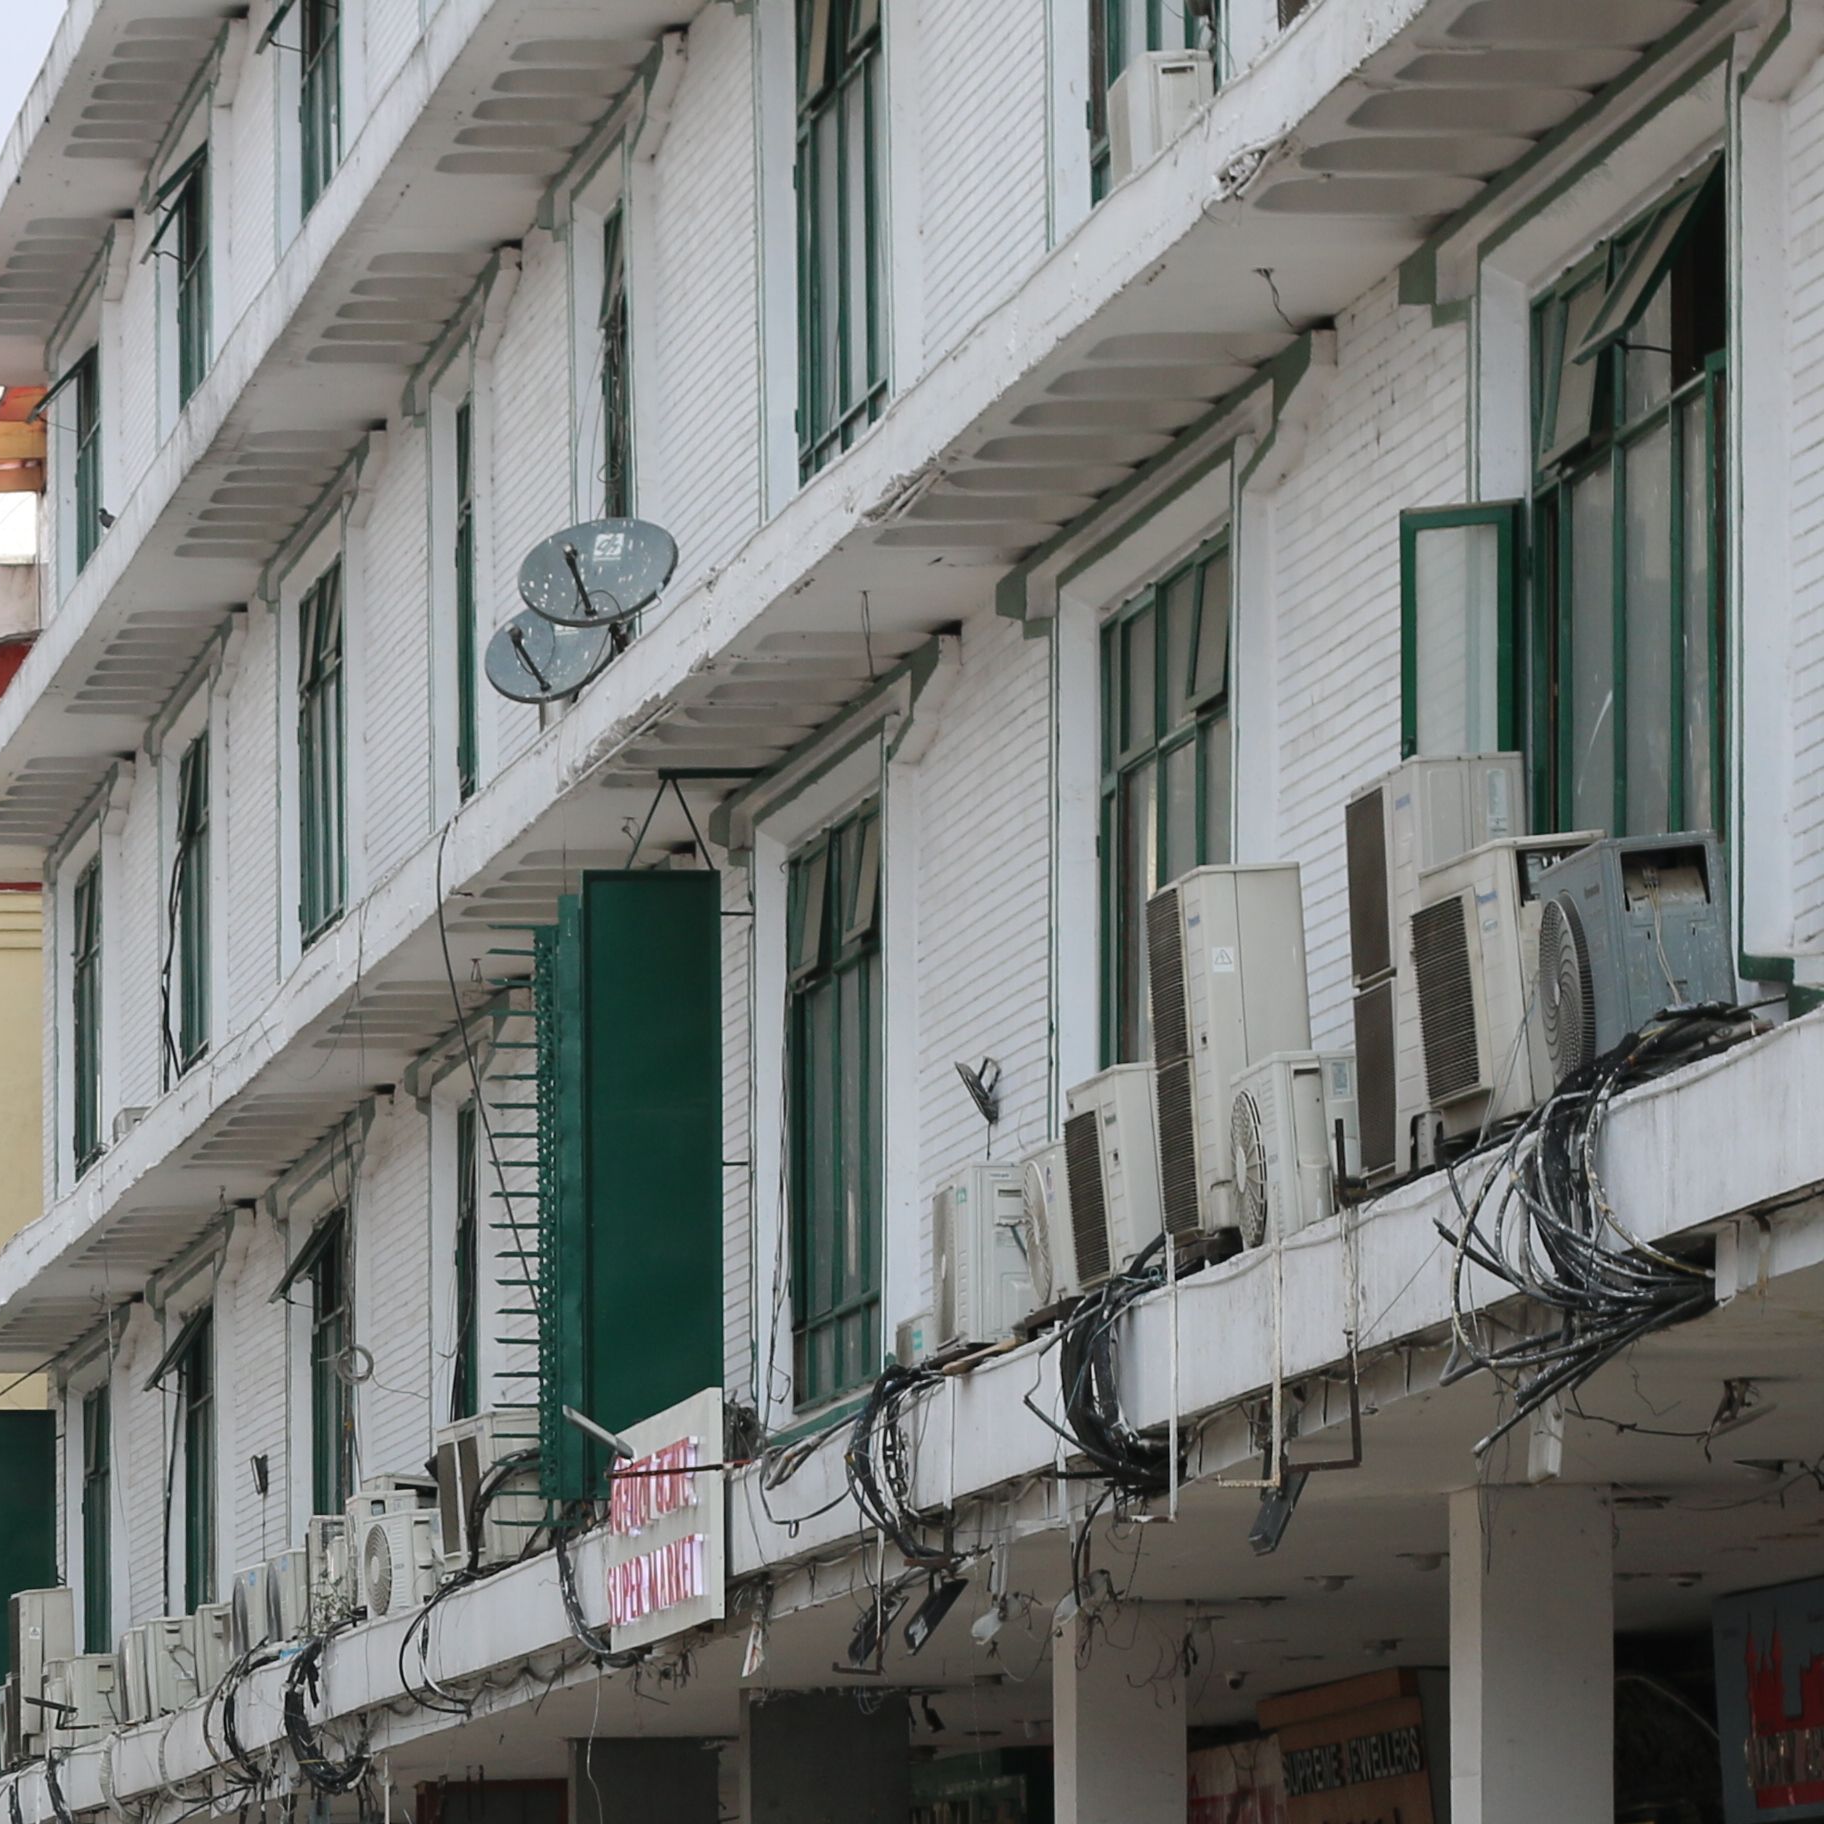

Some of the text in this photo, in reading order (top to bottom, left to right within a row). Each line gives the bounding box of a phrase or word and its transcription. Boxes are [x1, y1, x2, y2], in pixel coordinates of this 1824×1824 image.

[608, 1533, 703, 1627] SUPER MARKET
[1282, 1727, 1421, 1796] SUPREME JEWELLERS
